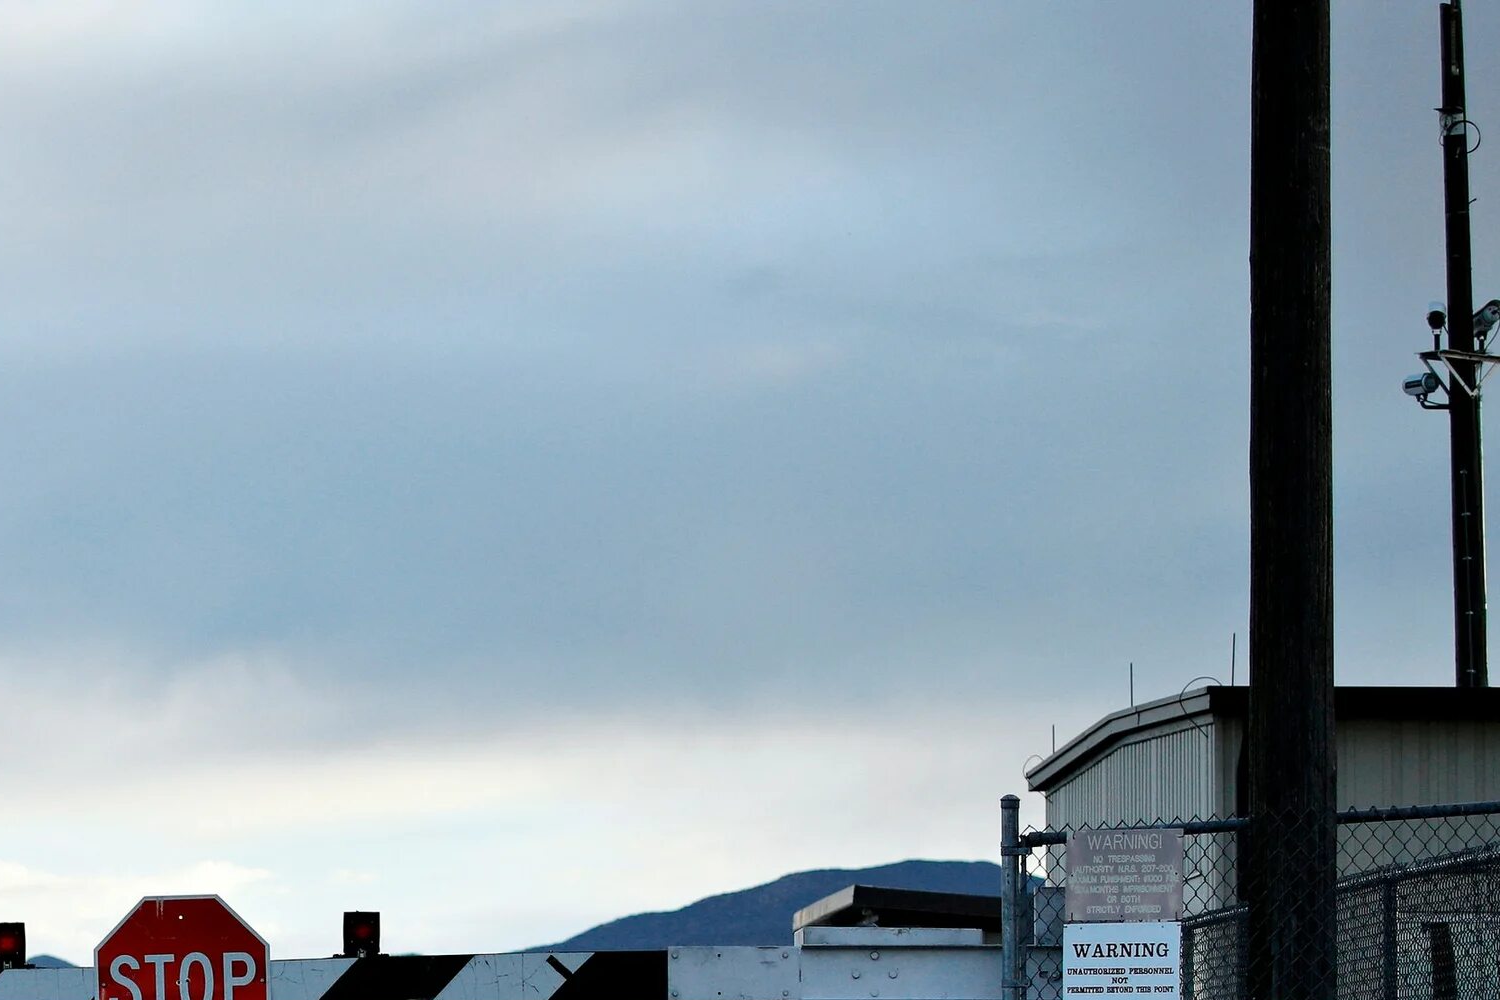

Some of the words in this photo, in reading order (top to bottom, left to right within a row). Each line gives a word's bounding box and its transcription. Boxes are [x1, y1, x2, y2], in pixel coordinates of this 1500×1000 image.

[1087, 833, 1162, 850] WARNING!
[1093, 855, 1104, 863] NO
[1108, 854, 1156, 863] TRESPASSING
[1075, 865, 1114, 874] AUTHORITY
[1107, 895, 1117, 903] OR
[1086, 905, 1121, 914] STRICTLY
[1073, 943, 1169, 958] WARNING
[1067, 986, 1104, 994] PERMITTED
